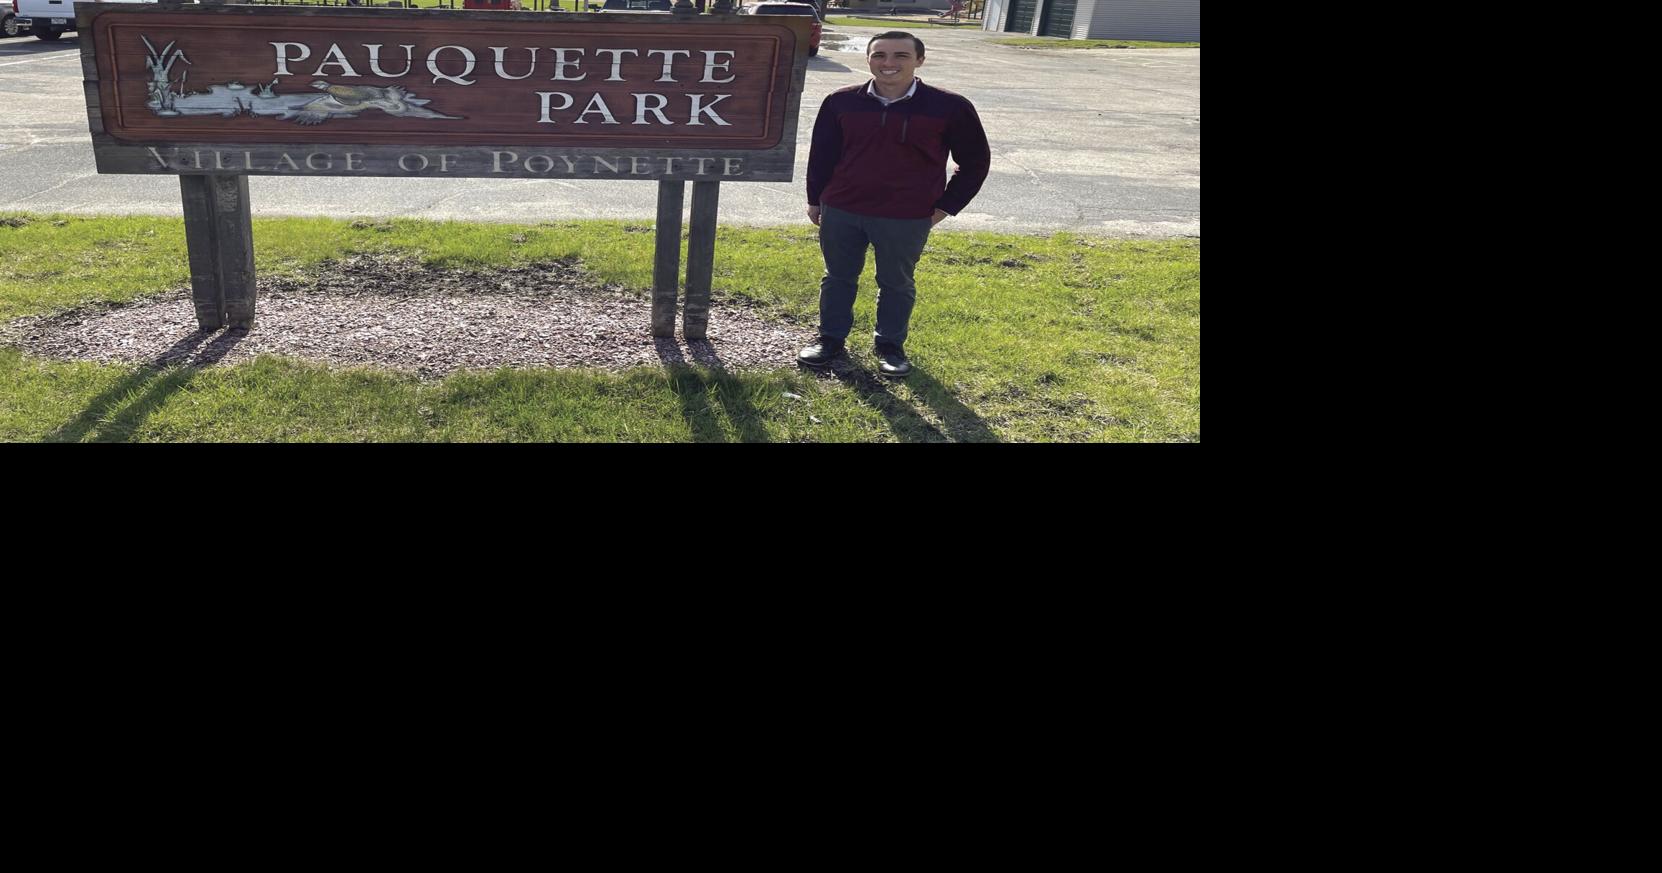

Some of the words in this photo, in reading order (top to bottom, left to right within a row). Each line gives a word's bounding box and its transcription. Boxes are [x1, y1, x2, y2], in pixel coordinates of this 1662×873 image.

[269, 41, 736, 85] PAUQUETTE
[536, 91, 733, 126] PARK
[147, 146, 364, 171] VILLAGE
[400, 153, 457, 172] OF
[491, 150, 745, 176] POYNETTE
